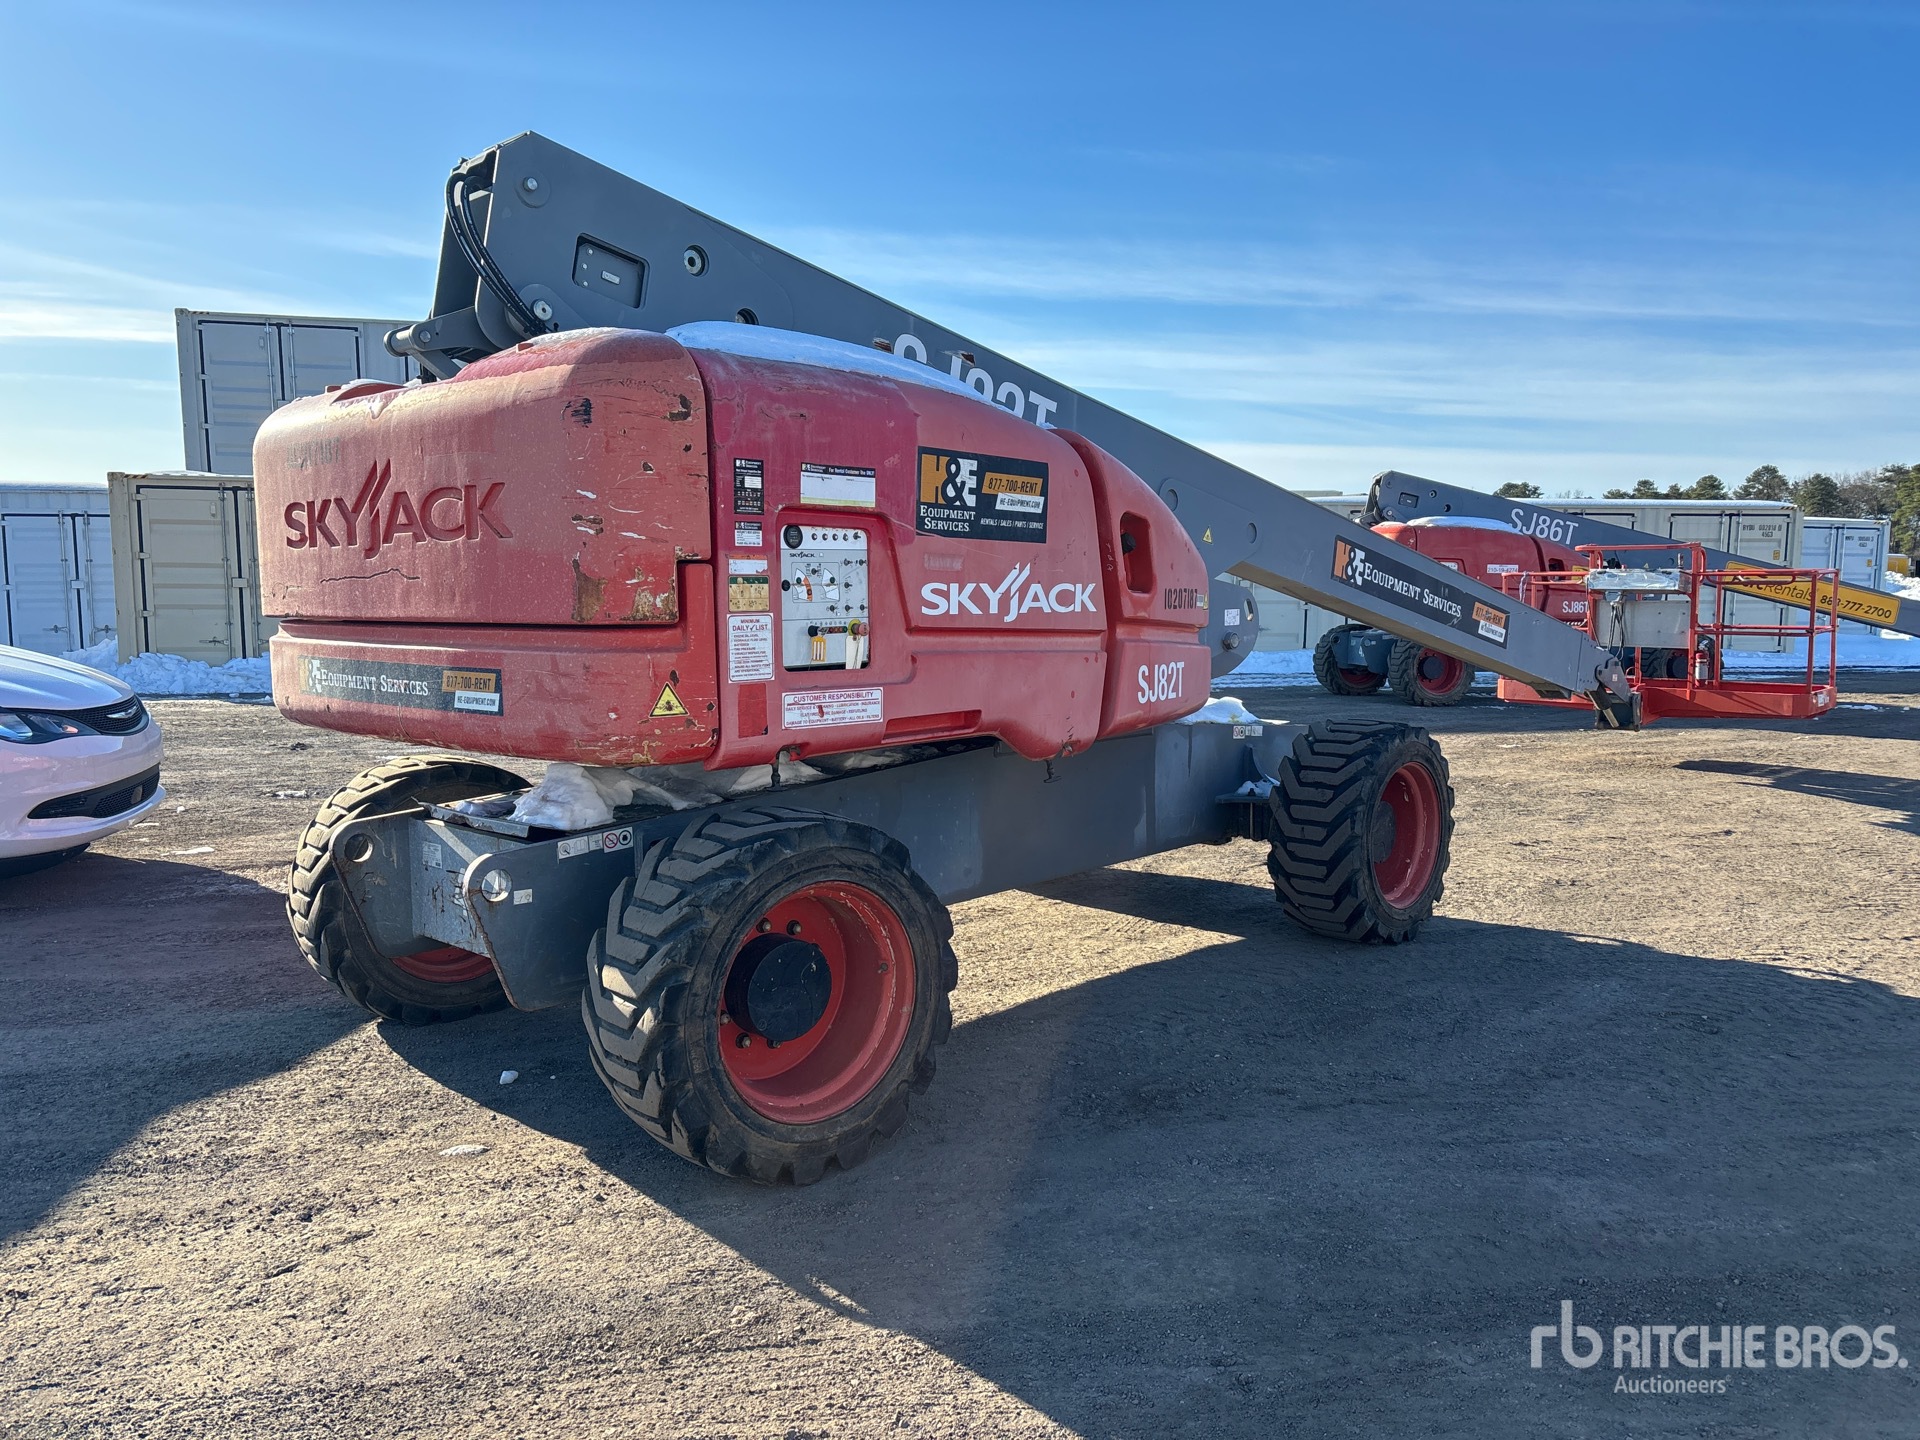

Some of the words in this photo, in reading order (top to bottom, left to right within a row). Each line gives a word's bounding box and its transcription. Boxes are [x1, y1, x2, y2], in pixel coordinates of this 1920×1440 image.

[920, 453, 978, 507] H&E
[988, 477, 1039, 494] 877-700-RENT
[284, 458, 514, 560] SKYJACK
[919, 505, 976, 521] EQUIPMENT
[924, 517, 969, 532] SERVICES
[1509, 508, 1579, 545] SJ86T
[1333, 540, 1366, 586] H&E
[920, 562, 1097, 622] SKYJACK
[1164, 587, 1198, 610] 10207187
[1363, 562, 1421, 601] EQUIPMENT
[1422, 588, 1462, 618] SERVICES
[755, 623, 768, 631] LIST
[320, 669, 377, 692] EQUIPMENT
[446, 674, 492, 691] 877-700-RENT
[1138, 661, 1185, 704] SJ82T
[793, 694, 827, 703] CUSTOMER
[828, 691, 874, 700] RESPONSIBILITY
